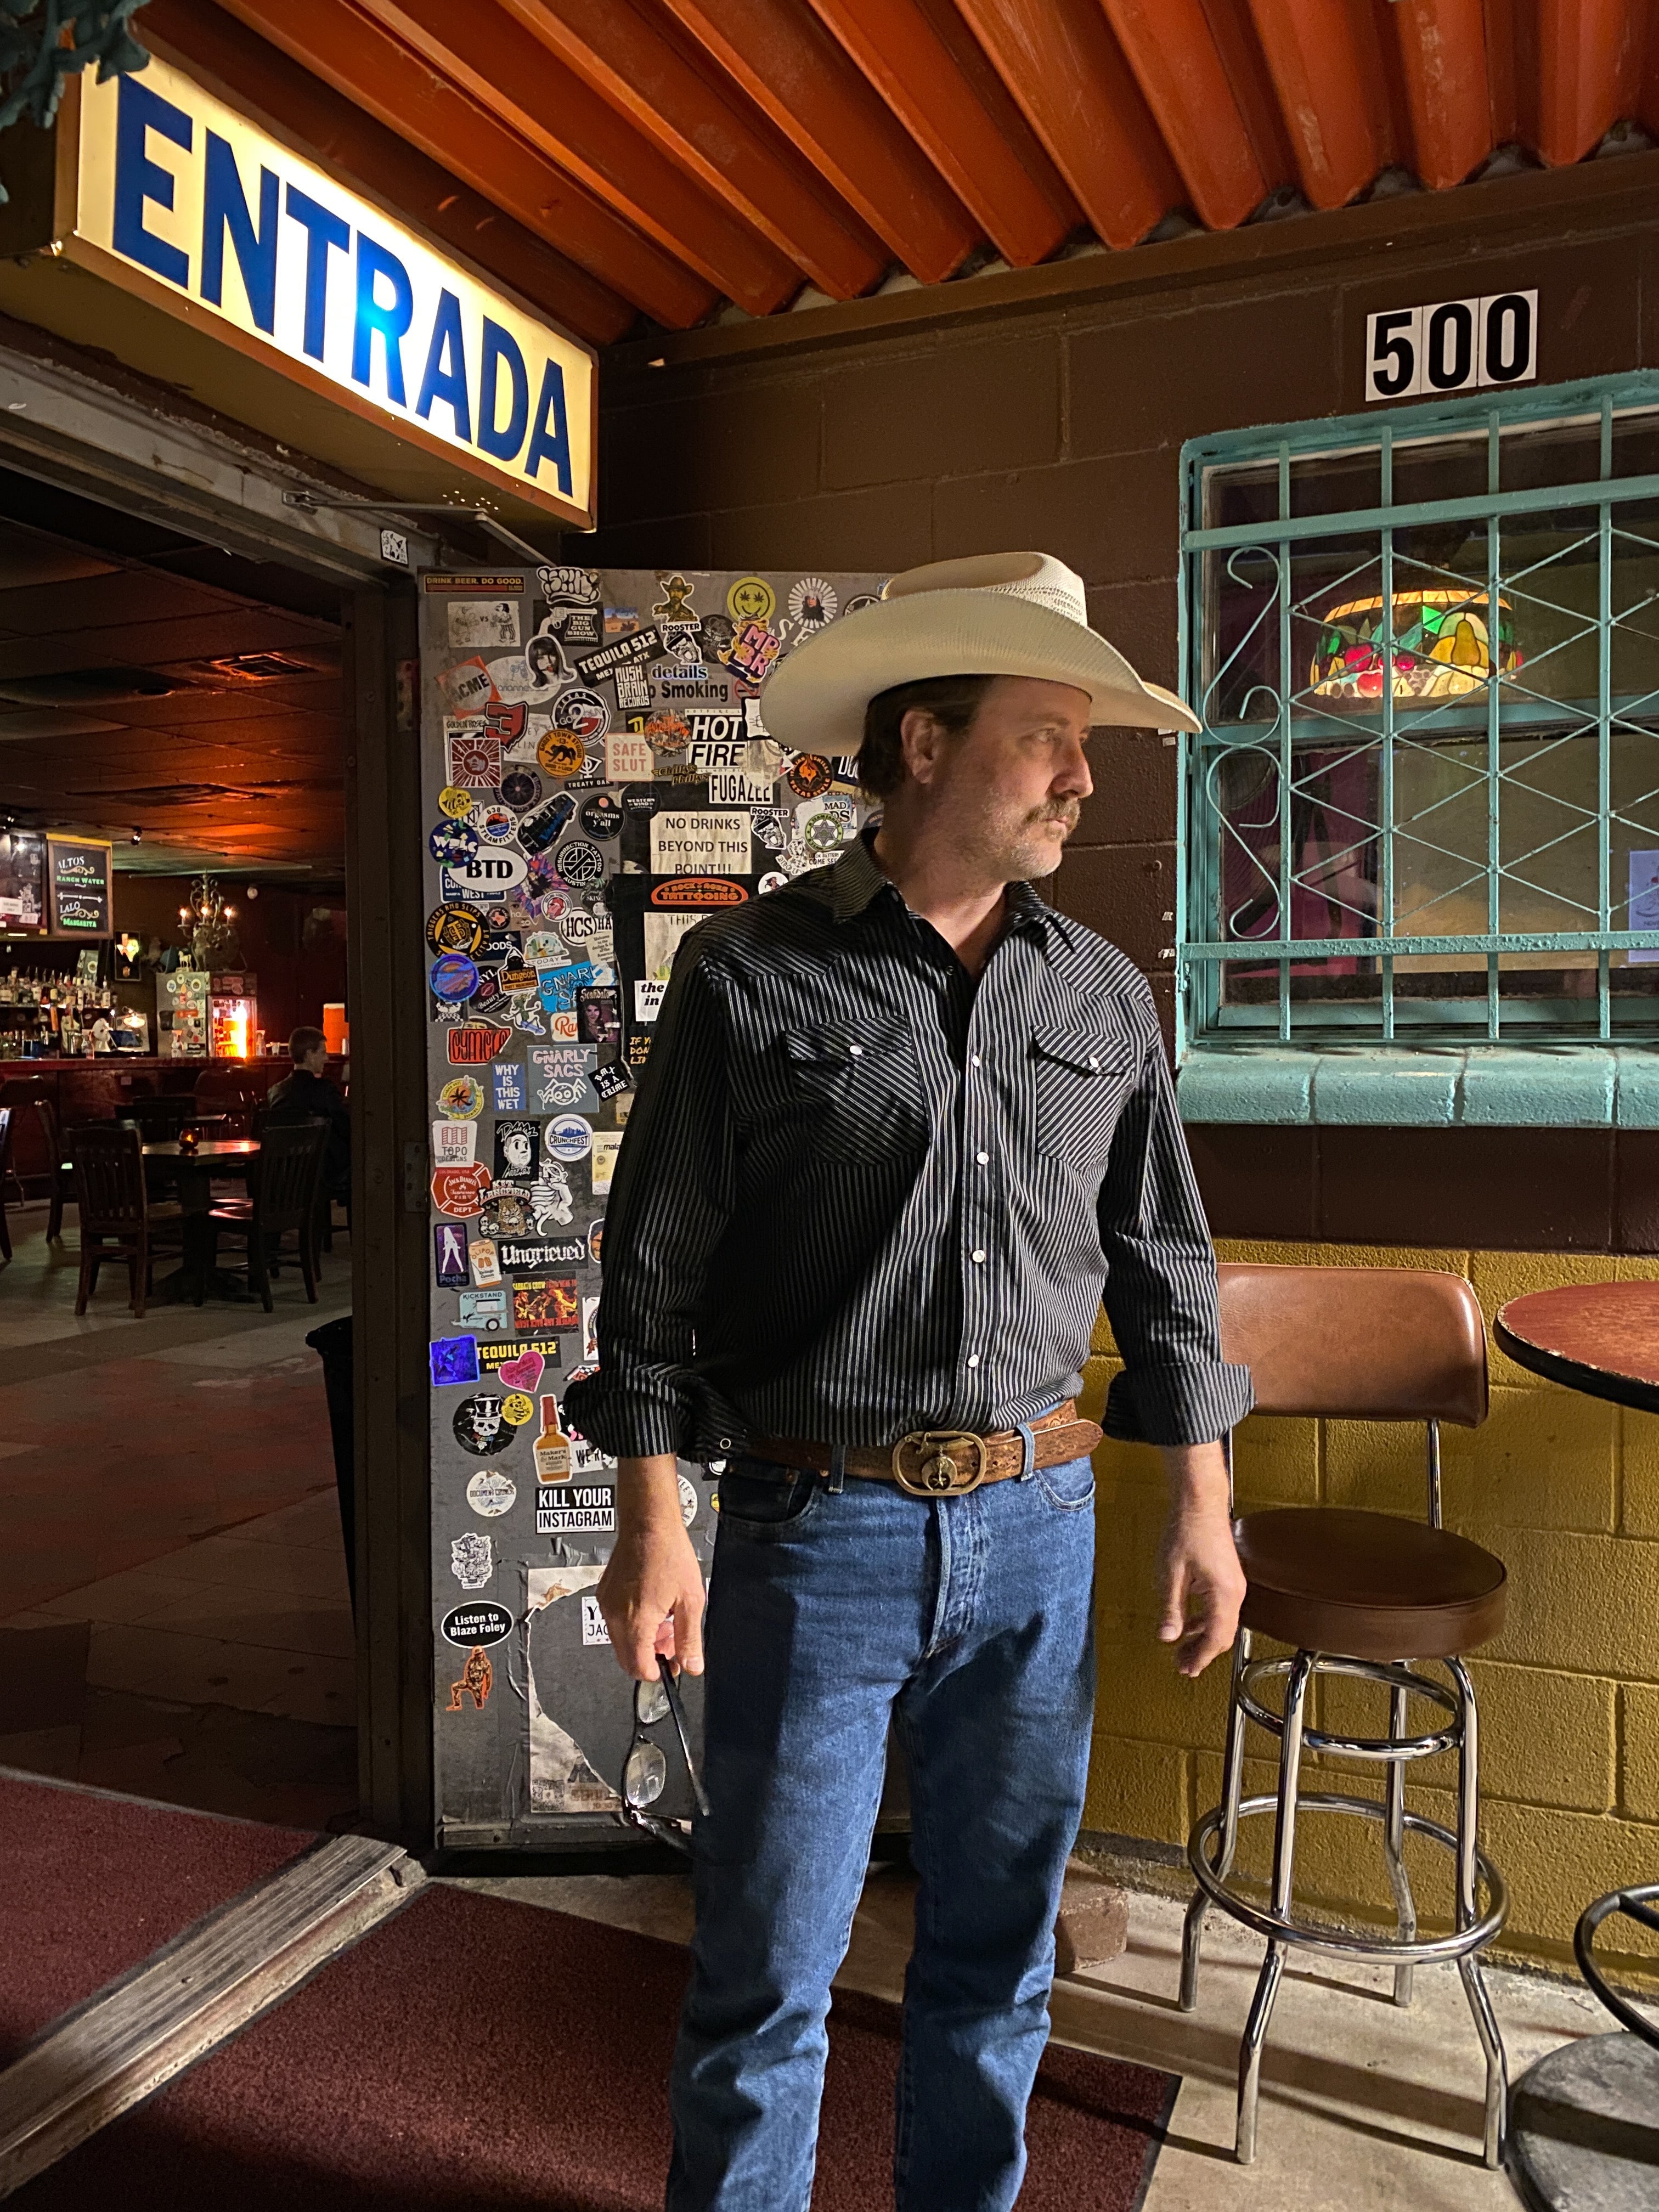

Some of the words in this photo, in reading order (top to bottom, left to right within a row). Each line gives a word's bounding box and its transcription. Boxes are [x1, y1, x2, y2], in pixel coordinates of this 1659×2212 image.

[112, 71, 573, 498] ENTRADA
[1373, 295, 1530, 396] 500
[662, 623, 699, 631] ROOSTER
[578, 642, 632, 674] TEQUILA
[630, 631, 658, 651] 512
[634, 651, 650, 664] ATX
[615, 665, 644, 683] MUSH
[652, 665, 707, 679] details
[617, 680, 648, 698] BRAIN
[661, 681, 729, 702] Smoking
[557, 692, 586, 709] TEXAS
[619, 695, 650, 708] RECORDS
[692, 716, 743, 740] HOT
[613, 743, 646, 756] SAFE
[691, 744, 746, 766] FIRE
[613, 759, 646, 771] SLUT
[790, 780, 811, 797] TEXAS
[825, 802, 847, 810] MAD
[585, 811, 620, 820] orgsms
[479, 816, 517, 844] STEAMFITTERS
[666, 818, 686, 829] NO
[691, 819, 741, 830] DRINKS
[658, 840, 714, 852] BEYOND
[718, 842, 748, 853] THIS
[557, 842, 589, 872] RESURRECTION
[591, 847, 602, 872] TATTOO
[467, 860, 513, 878] BTD
[675, 864, 731, 874] POINT!!!
[563, 877, 586, 887] AUSTIN
[661, 892, 738, 900] TATTOOING
[60, 901, 81, 913] LALO
[461, 904, 481, 917] SLIPS
[566, 917, 594, 937] HCS
[501, 970, 536, 982] Dungeon
[641, 982, 664, 992] the
[478, 993, 499, 1009] Beauty
[533, 1049, 591, 1064] GNARLY
[495, 1064, 519, 1076] WHY
[544, 1064, 584, 1077] SACS
[503, 1076, 512, 1086] IS
[495, 1087, 520, 1098] THIS
[498, 1099, 519, 1109] WET
[550, 1135, 589, 1146] CRUNCHFEST
[442, 1147, 467, 1155] TOPO
[471, 1248, 494, 1260] OLIPOP
[439, 1274, 467, 1283] Pocha
[477, 1343, 528, 1359] TEQUILA
[531, 1341, 556, 1355] 512
[539, 1489, 569, 1508] KILL
[572, 1488, 612, 1507] YOUR
[539, 1510, 612, 1528] INSTAGRAM
[455, 1615, 486, 1626] Listen
[488, 1613, 499, 1622] to
[450, 1626, 477, 1637] Blaze
[479, 1622, 506, 1634] Foley
